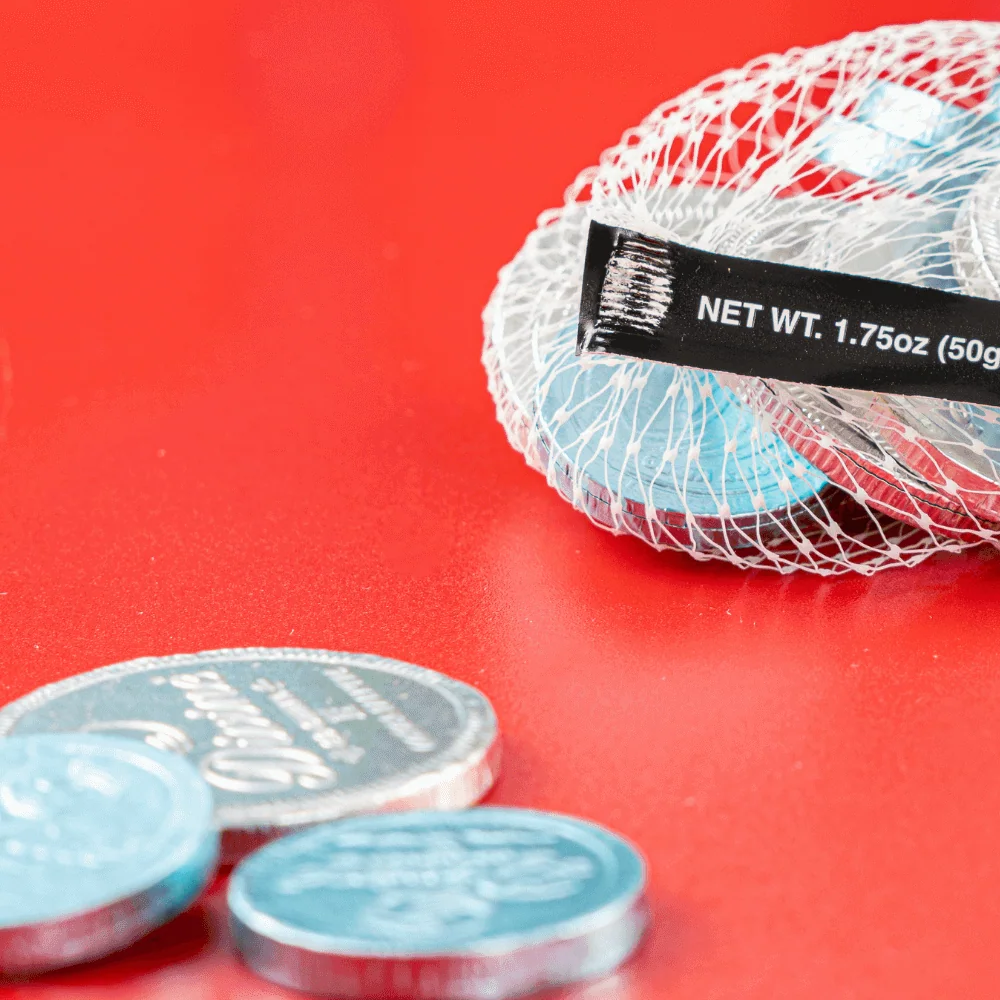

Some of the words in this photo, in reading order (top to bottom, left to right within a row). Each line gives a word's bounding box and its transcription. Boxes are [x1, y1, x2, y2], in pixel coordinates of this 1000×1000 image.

[698, 295, 763, 328] NET
[772, 307, 822, 339] WT.
[835, 319, 930, 355] 1.75oz
